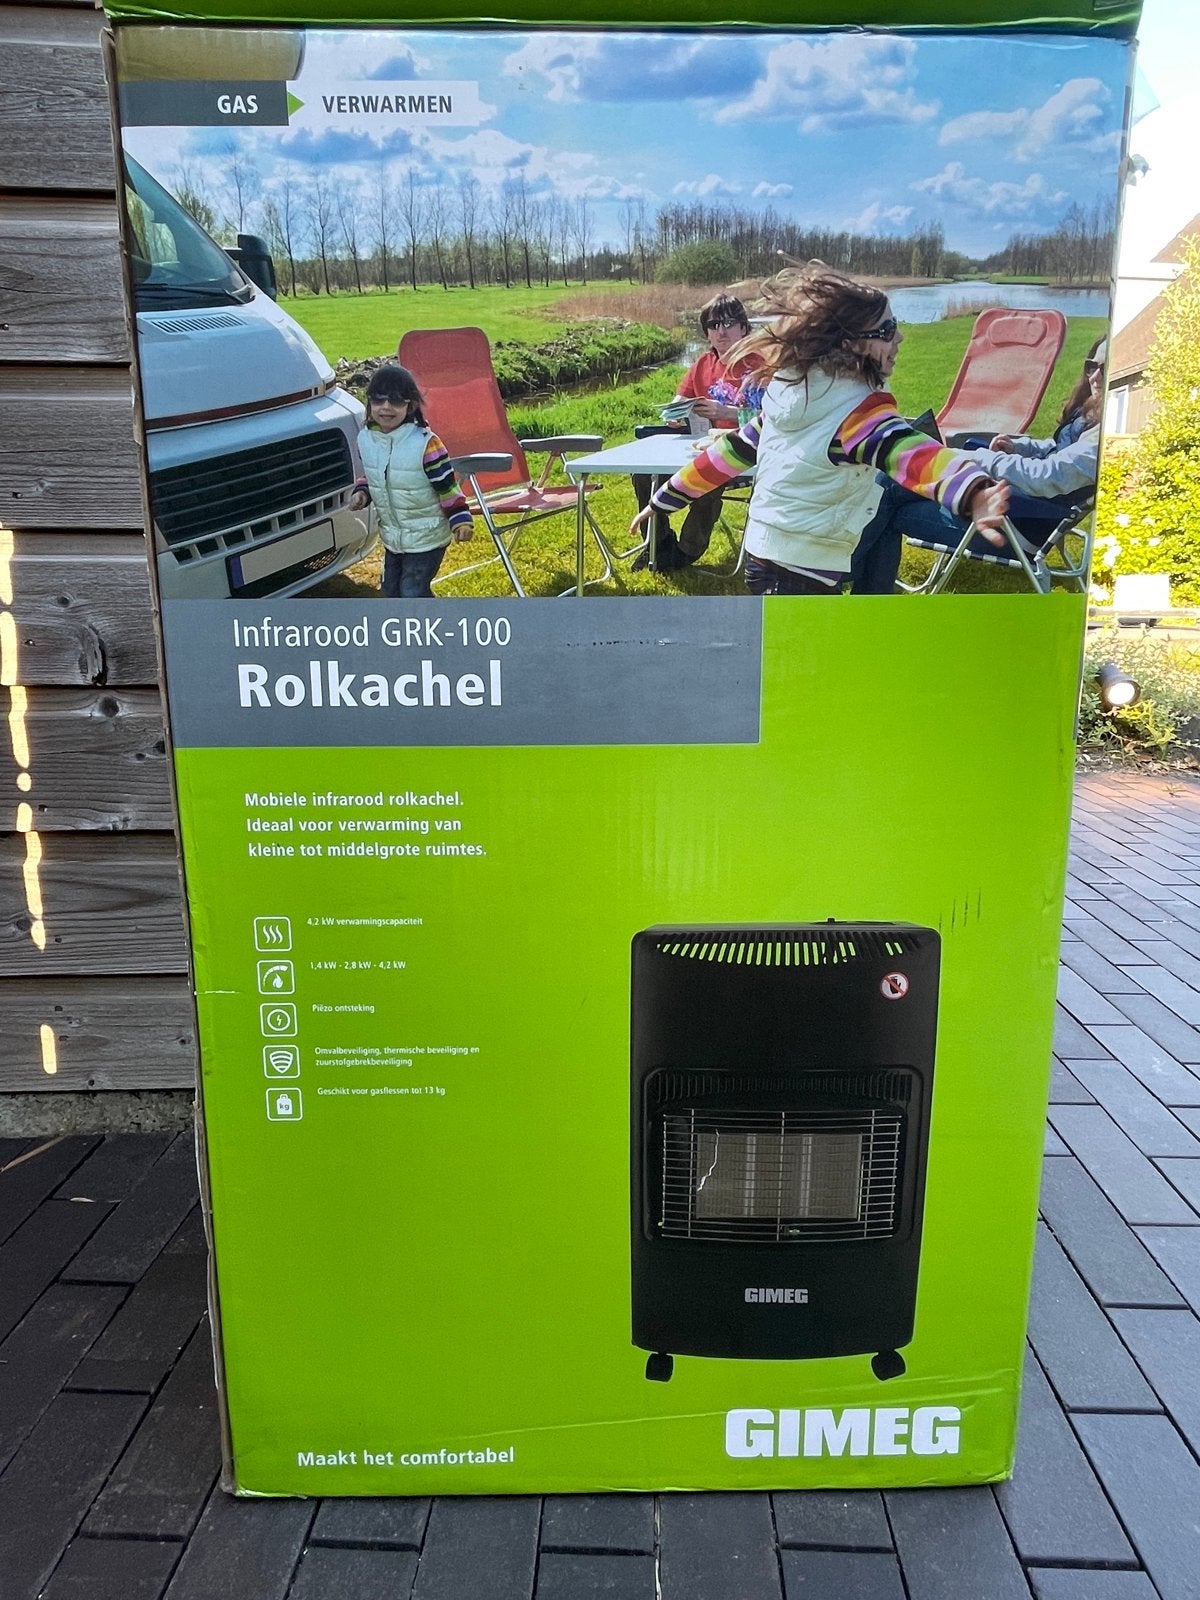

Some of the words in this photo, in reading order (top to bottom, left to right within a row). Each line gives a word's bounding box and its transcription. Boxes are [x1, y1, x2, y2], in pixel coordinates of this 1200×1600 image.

[217, 94, 259, 114] GAS
[321, 95, 452, 114] VERWARMEN
[233, 616, 369, 647] Infrarood
[381, 617, 511, 647] GRK-100
[237, 659, 502, 708] Rolkachel
[244, 792, 307, 807] Mobiele
[312, 791, 384, 806] infrarood
[389, 791, 464, 806] rolkachel.
[246, 817, 294, 832] Ideaal
[299, 820, 334, 832] voor
[339, 817, 430, 835] verwarming
[435, 819, 462, 831] van
[248, 842, 295, 857] kleine
[300, 843, 323, 857] tot
[327, 842, 421, 860] middelgrote
[425, 842, 487, 857] ruimtes.
[306, 917, 320, 926] 4,2
[321, 917, 335, 926] kW
[336, 917, 423, 927] verwarmingscapaciteit
[310, 961, 323, 970] 1,4
[323, 961, 337, 970] kW
[344, 961, 358, 970] 2,8
[358, 961, 372, 969] kW
[378, 961, 392, 970] 4,2
[393, 960, 406, 969] kW
[312, 1004, 333, 1012] Piëzo
[335, 1003, 375, 1014] ontsteking
[314, 1046, 382, 1057] Omvalbeveiliging,
[384, 1046, 426, 1055] thermische
[427, 1046, 469, 1056] beveiliging
[315, 1057, 413, 1068] zuurstofgebrekbeveiliging
[317, 1087, 350, 1095] Geschikt
[370, 1086, 410, 1097] gasflessen
[411, 1087, 422, 1095] tot
[425, 1086, 434, 1094] 13
[436, 1086, 446, 1096] kg
[279, 1102, 290, 1112] kg
[744, 1287, 809, 1304] GIMEG
[724, 1406, 961, 1459] GIMEG
[297, 1450, 358, 1467] Maakt
[363, 1449, 394, 1467] het
[400, 1446, 515, 1467] comfortabel
